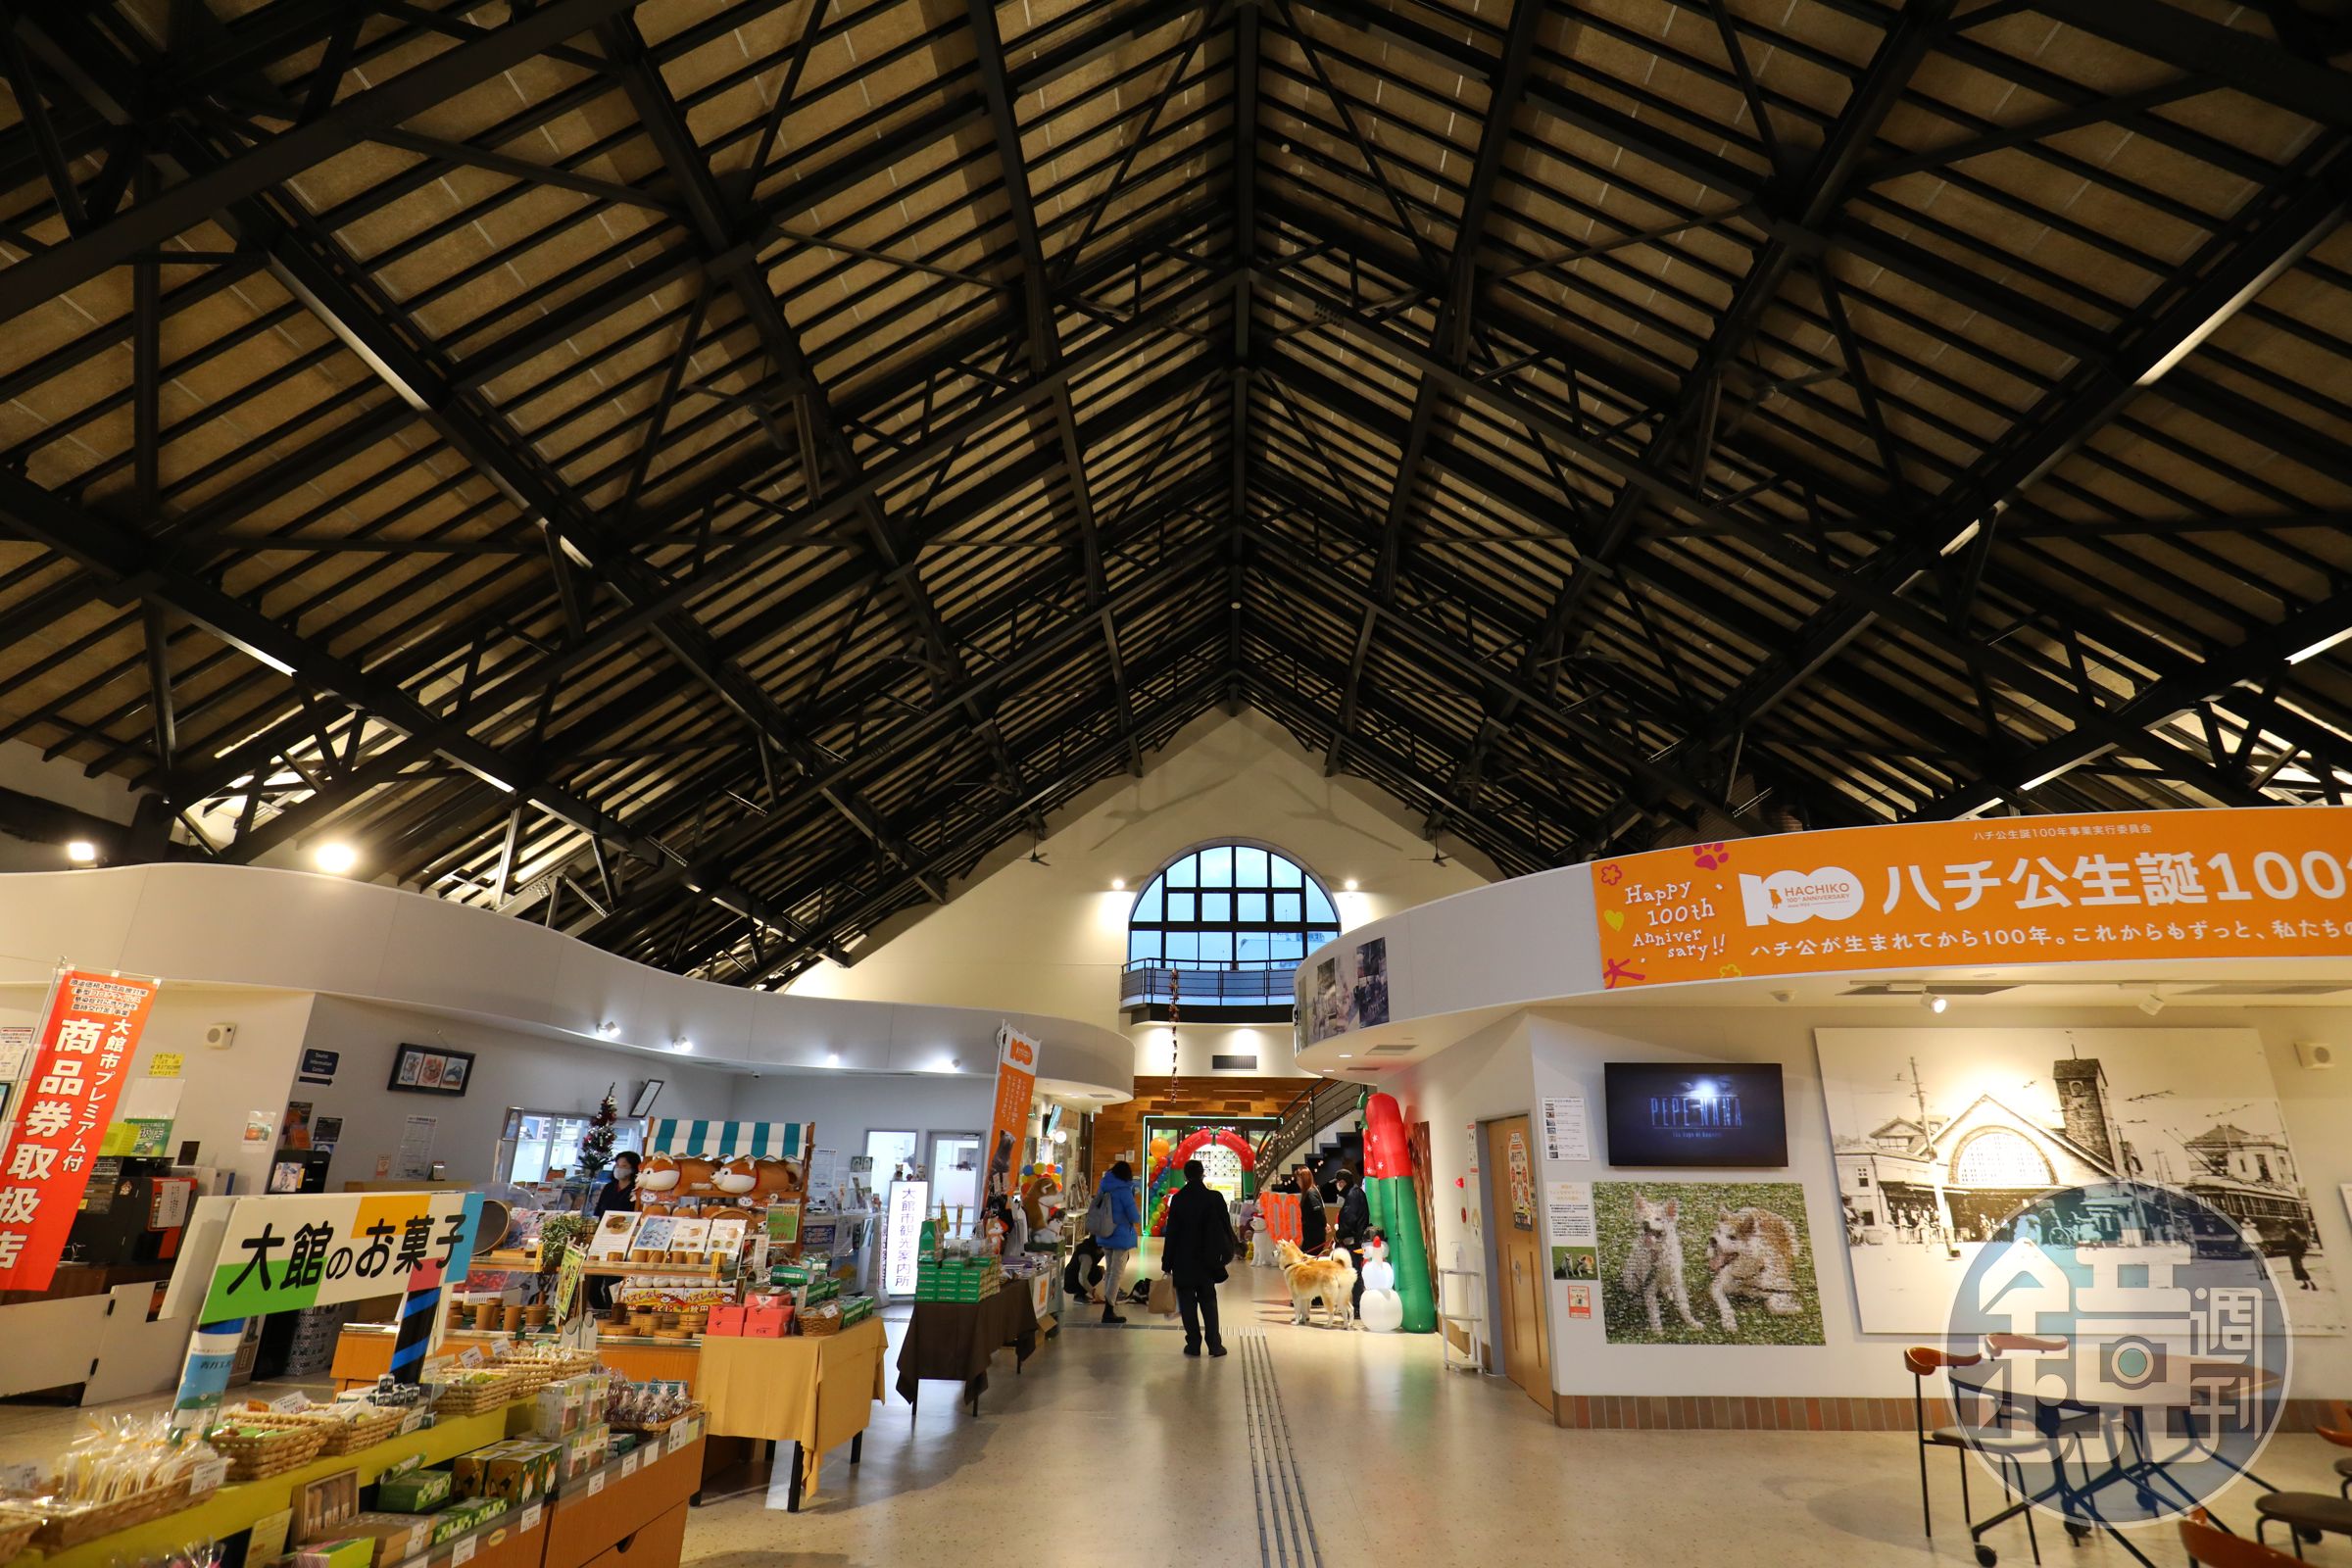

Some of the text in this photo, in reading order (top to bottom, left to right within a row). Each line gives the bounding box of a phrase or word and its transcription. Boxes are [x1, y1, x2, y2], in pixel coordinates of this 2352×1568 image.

[1973, 824, 2152, 841] ハチ公生誕100年事業実行委員会
[1624, 881, 1691, 906] Happy
[1784, 882, 1850, 897] HACHIKO
[1801, 893, 1850, 903] ANNIVERSARY
[1883, 851, 2352, 915] ハチ公生誕100
[1646, 898, 1715, 927] 100th
[1632, 928, 1702, 948] Anniver
[63, 1019, 132, 1172] 大館市プレミアム付
[1650, 1094, 1742, 1127] PEPE NANA
[0, 1018, 106, 1269] 商品券取扱店
[895, 1187, 916, 1287] 大館市観光案内所
[226, 1213, 466, 1296] 大館のお菓子
